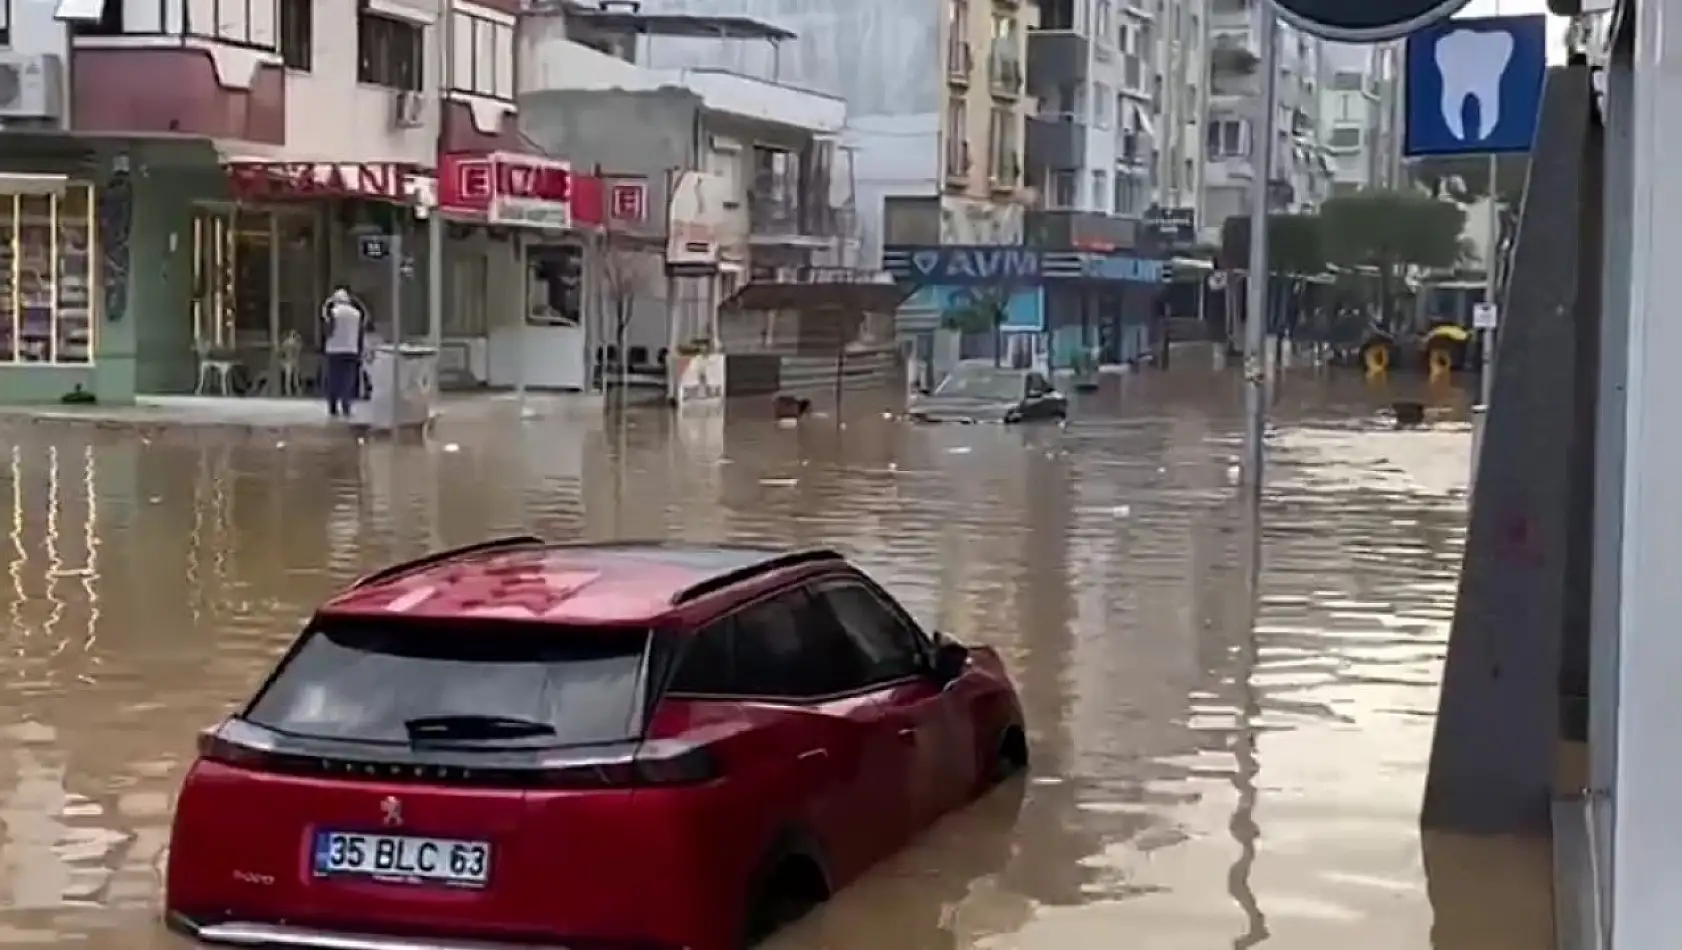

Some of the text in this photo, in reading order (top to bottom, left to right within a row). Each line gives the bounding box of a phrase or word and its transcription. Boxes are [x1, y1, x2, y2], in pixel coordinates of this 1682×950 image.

[946, 249, 1038, 277] AVM
[331, 836, 486, 876] 35 BLC 63
